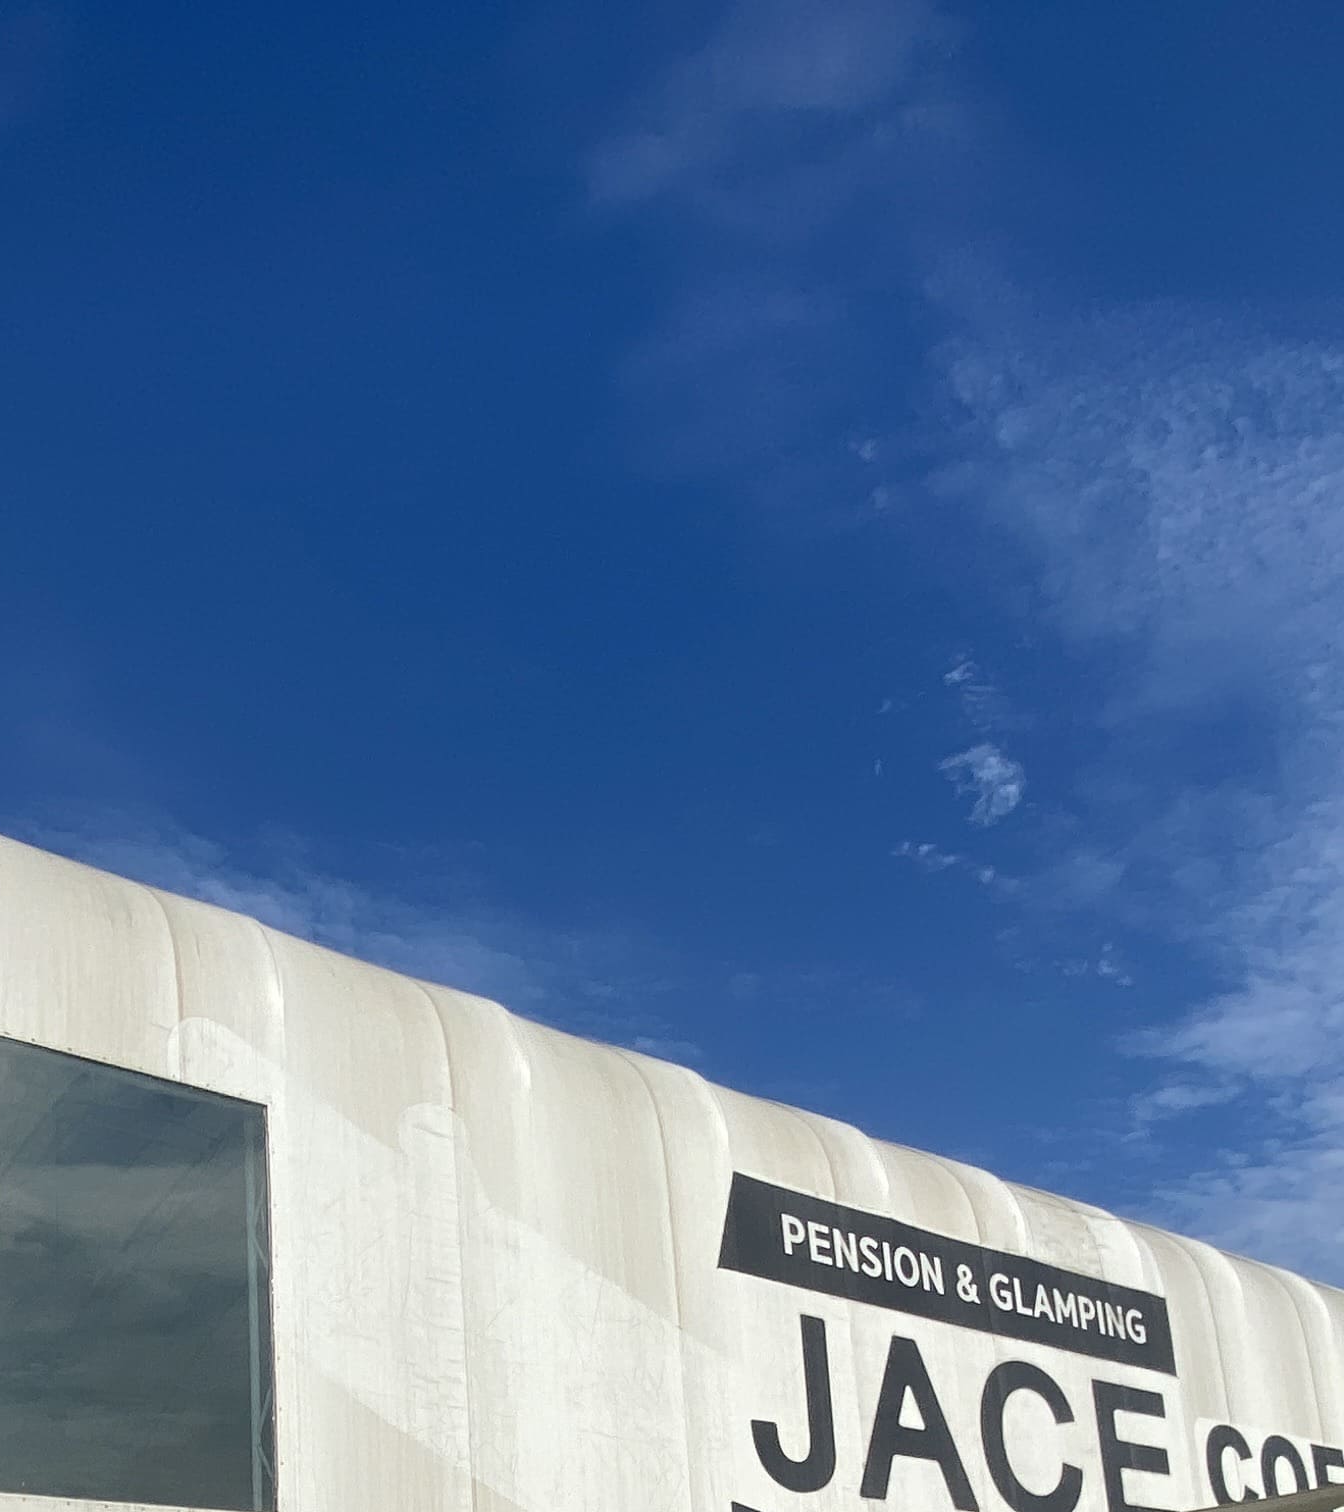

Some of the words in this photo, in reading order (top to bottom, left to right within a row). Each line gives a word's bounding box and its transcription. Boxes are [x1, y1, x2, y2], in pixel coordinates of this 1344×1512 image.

[780, 1212, 945, 1295] PENSION
[956, 1263, 981, 1305] &
[989, 1271, 1147, 1345] GLAMPING
